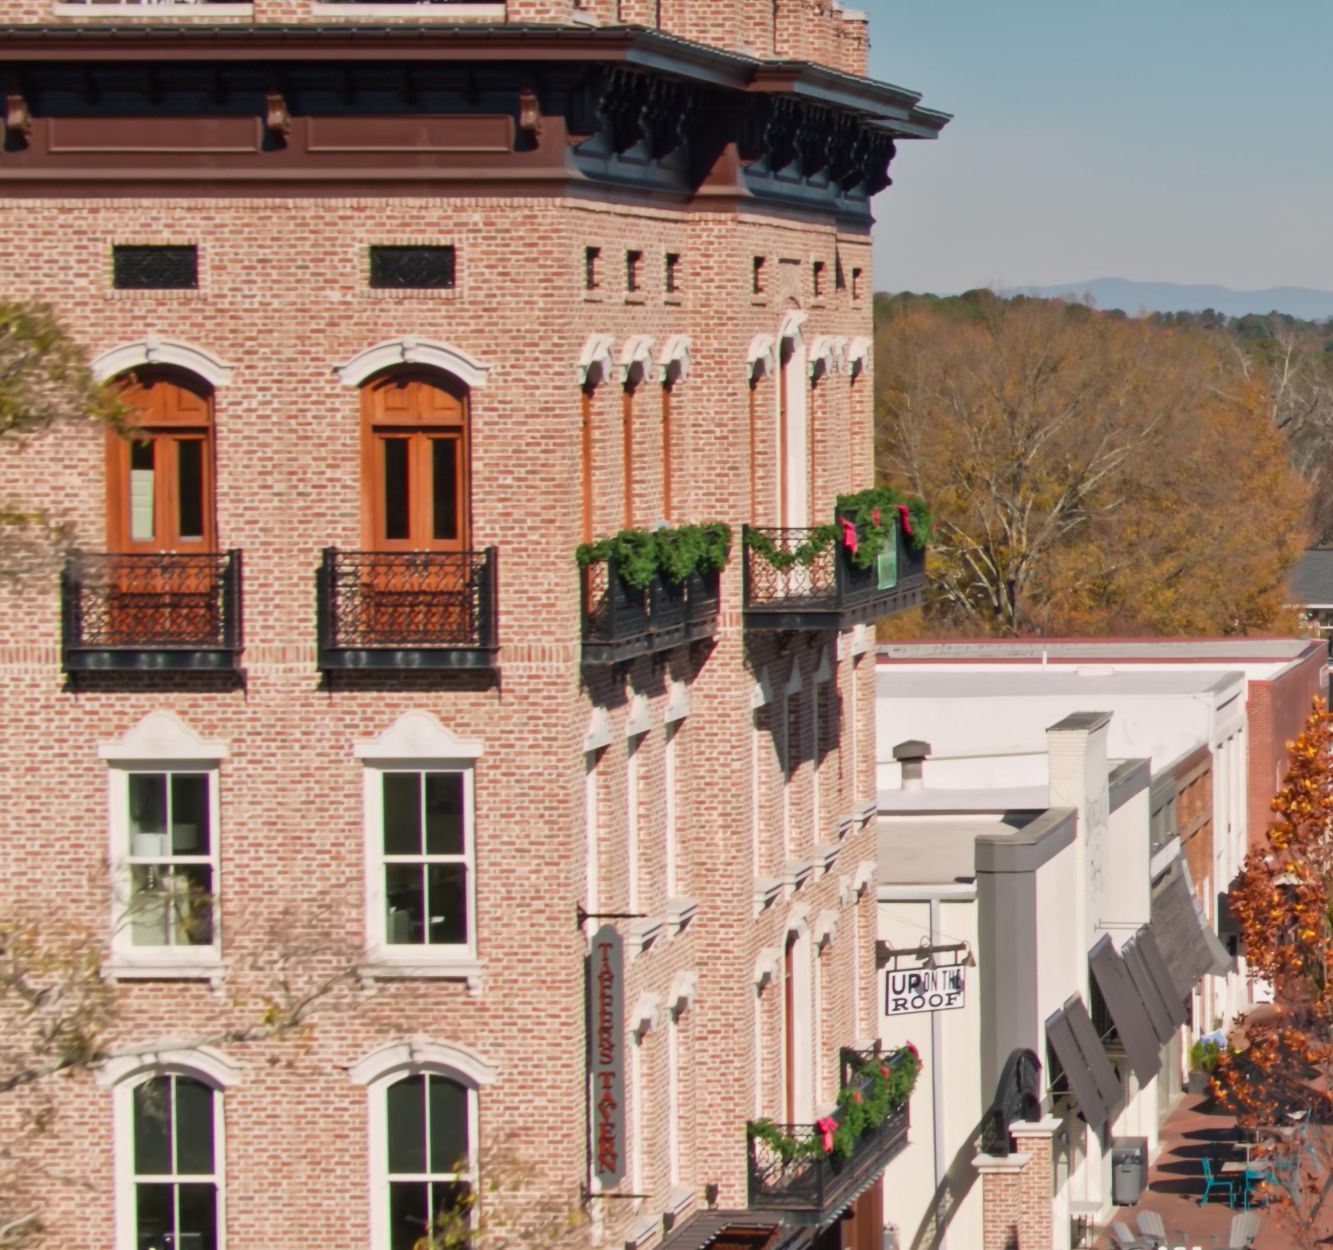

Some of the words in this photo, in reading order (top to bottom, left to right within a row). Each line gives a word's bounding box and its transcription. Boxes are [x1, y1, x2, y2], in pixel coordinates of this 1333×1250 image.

[892, 972, 922, 996] UP
[923, 969, 938, 993] ON
[892, 992, 961, 1012] ROOF
[597, 1071, 618, 1175] TAVERN
